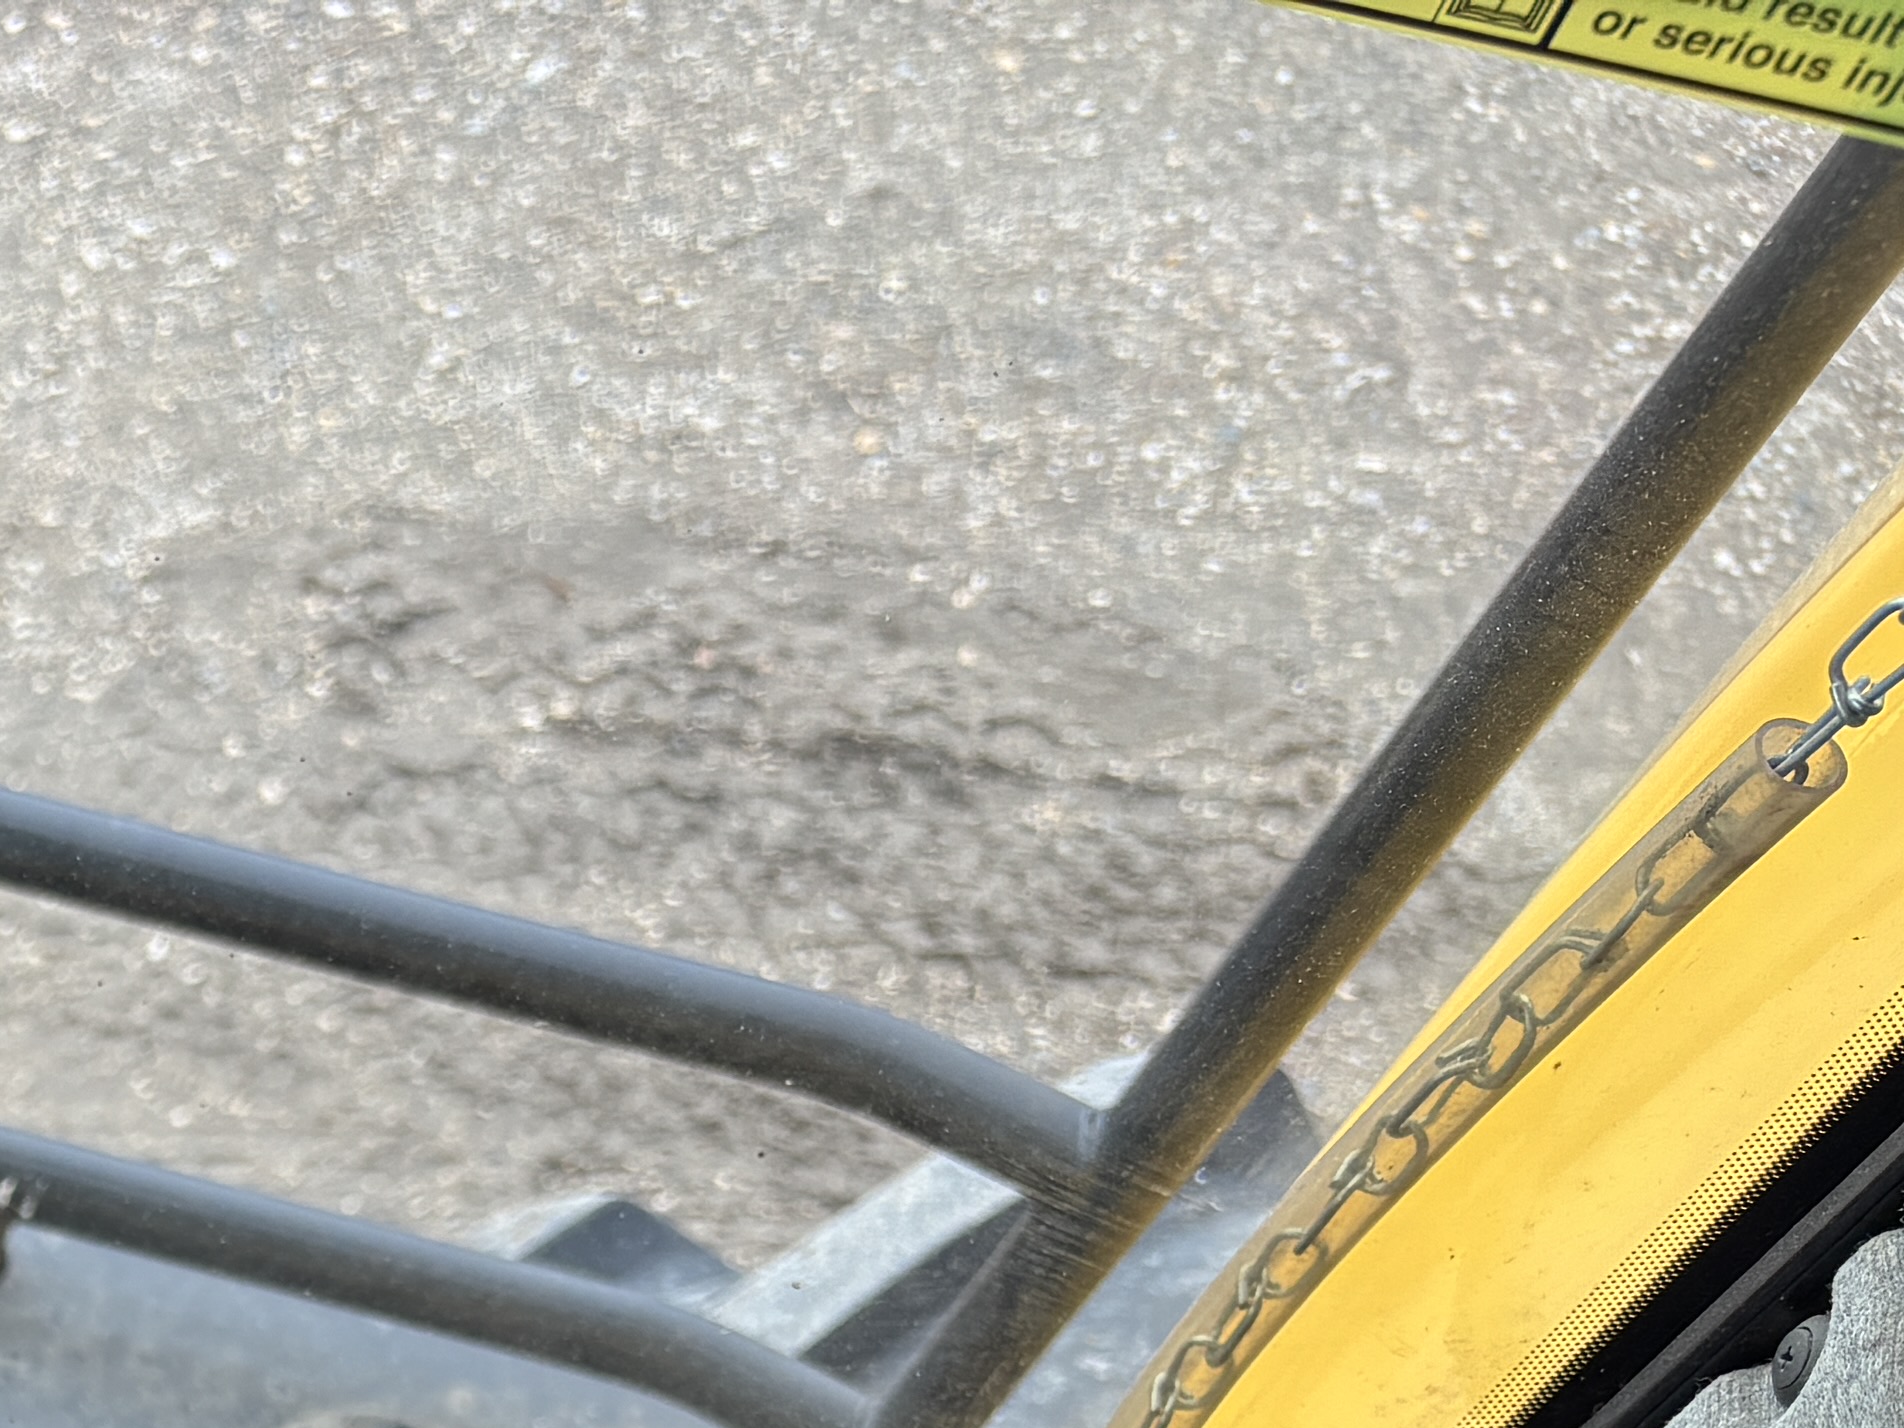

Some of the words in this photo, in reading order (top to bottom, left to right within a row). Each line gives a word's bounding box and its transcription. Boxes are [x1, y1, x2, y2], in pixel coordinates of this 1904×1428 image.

[1591, 9, 1648, 40] or
[1652, 22, 1834, 83] serious
[1842, 57, 1904, 108] inj
